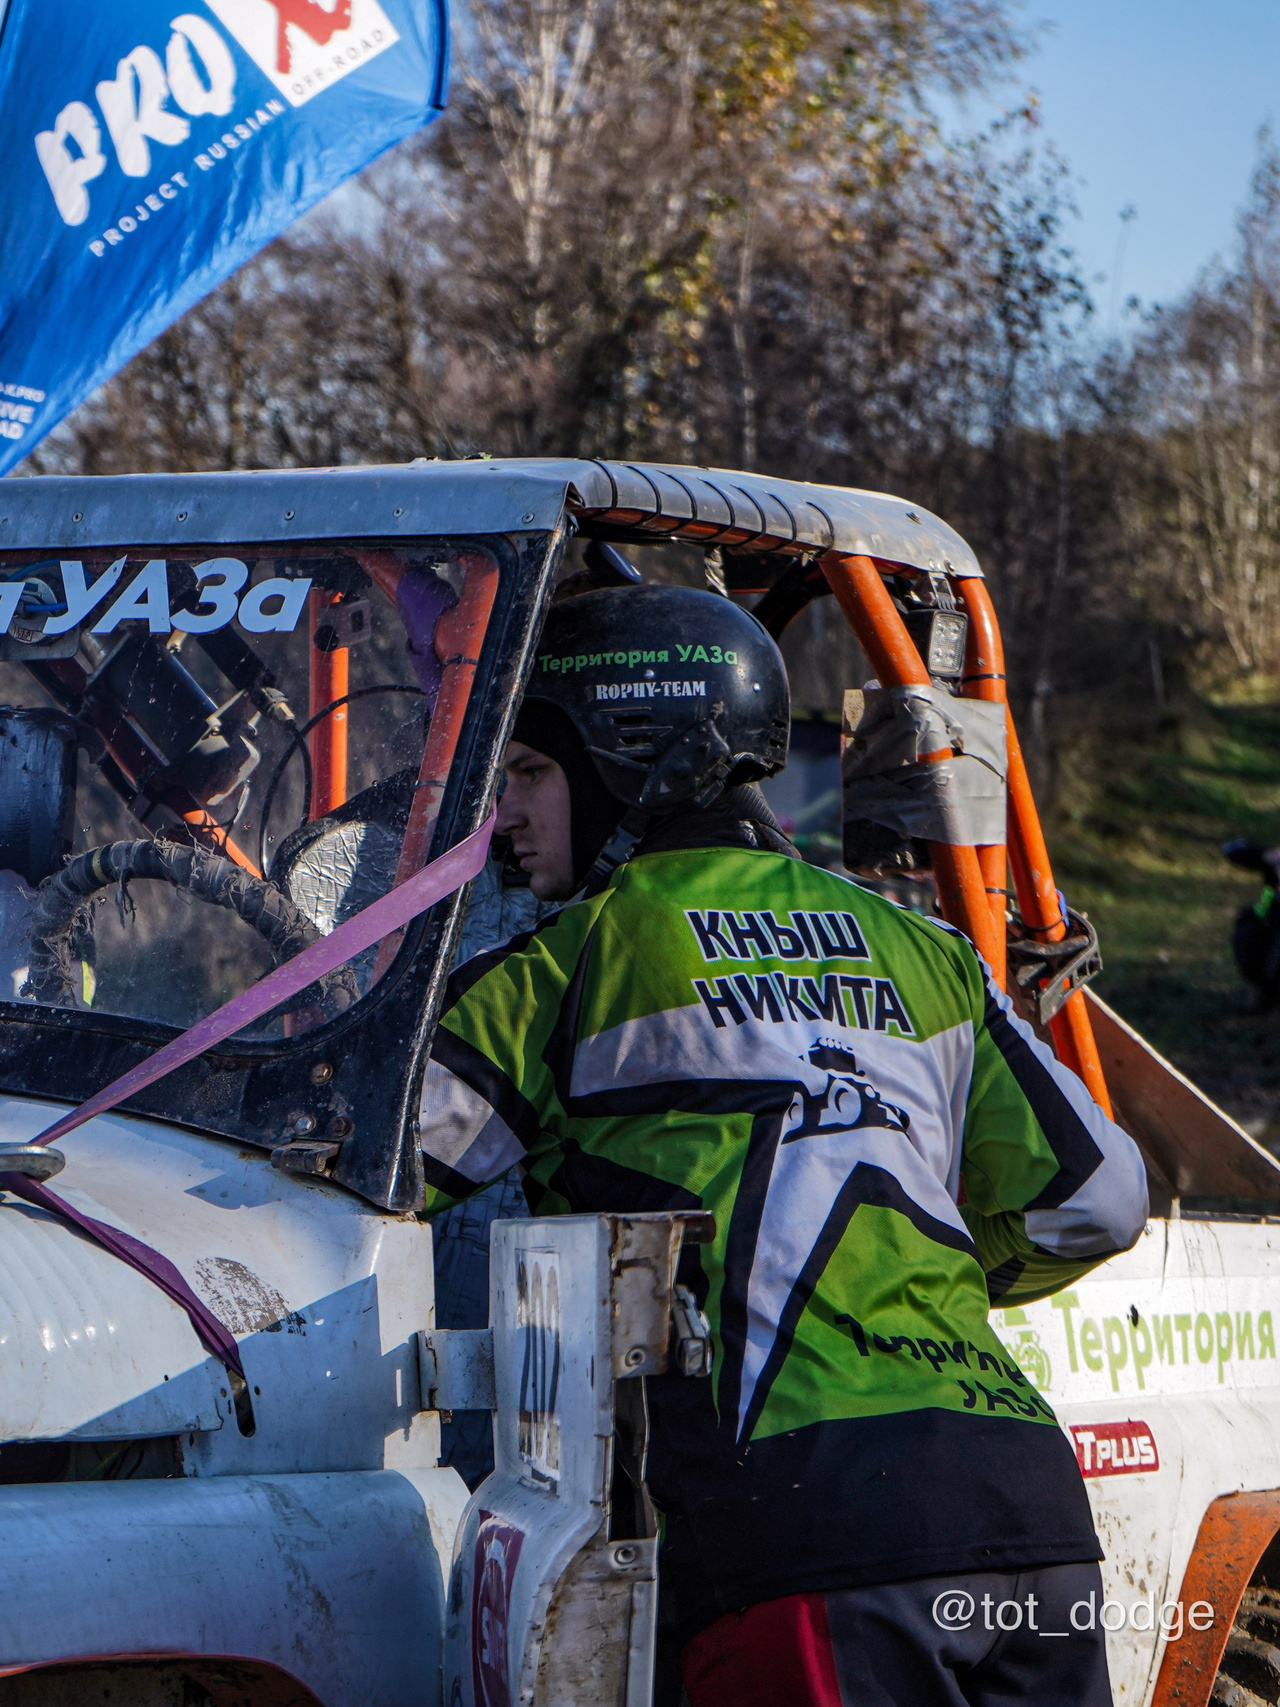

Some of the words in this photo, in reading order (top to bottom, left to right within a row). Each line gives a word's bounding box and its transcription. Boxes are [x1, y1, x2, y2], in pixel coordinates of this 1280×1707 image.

[291, 28, 385, 96] OFF-ROAD
[34, 13, 237, 226] PRO
[89, 171, 189, 257] PROJECT
[194, 98, 286, 171] RUSSIAN
[42, 554, 312, 635] УАЗа
[538, 649, 669, 673] Территория
[676, 644, 739, 666] УАЗа
[683, 908, 872, 962] КНЫШ
[690, 970, 917, 1037] НИКИТА
[1050, 1290, 1276, 1393] Территория
[1075, 1430, 1156, 1471] TPLUS
